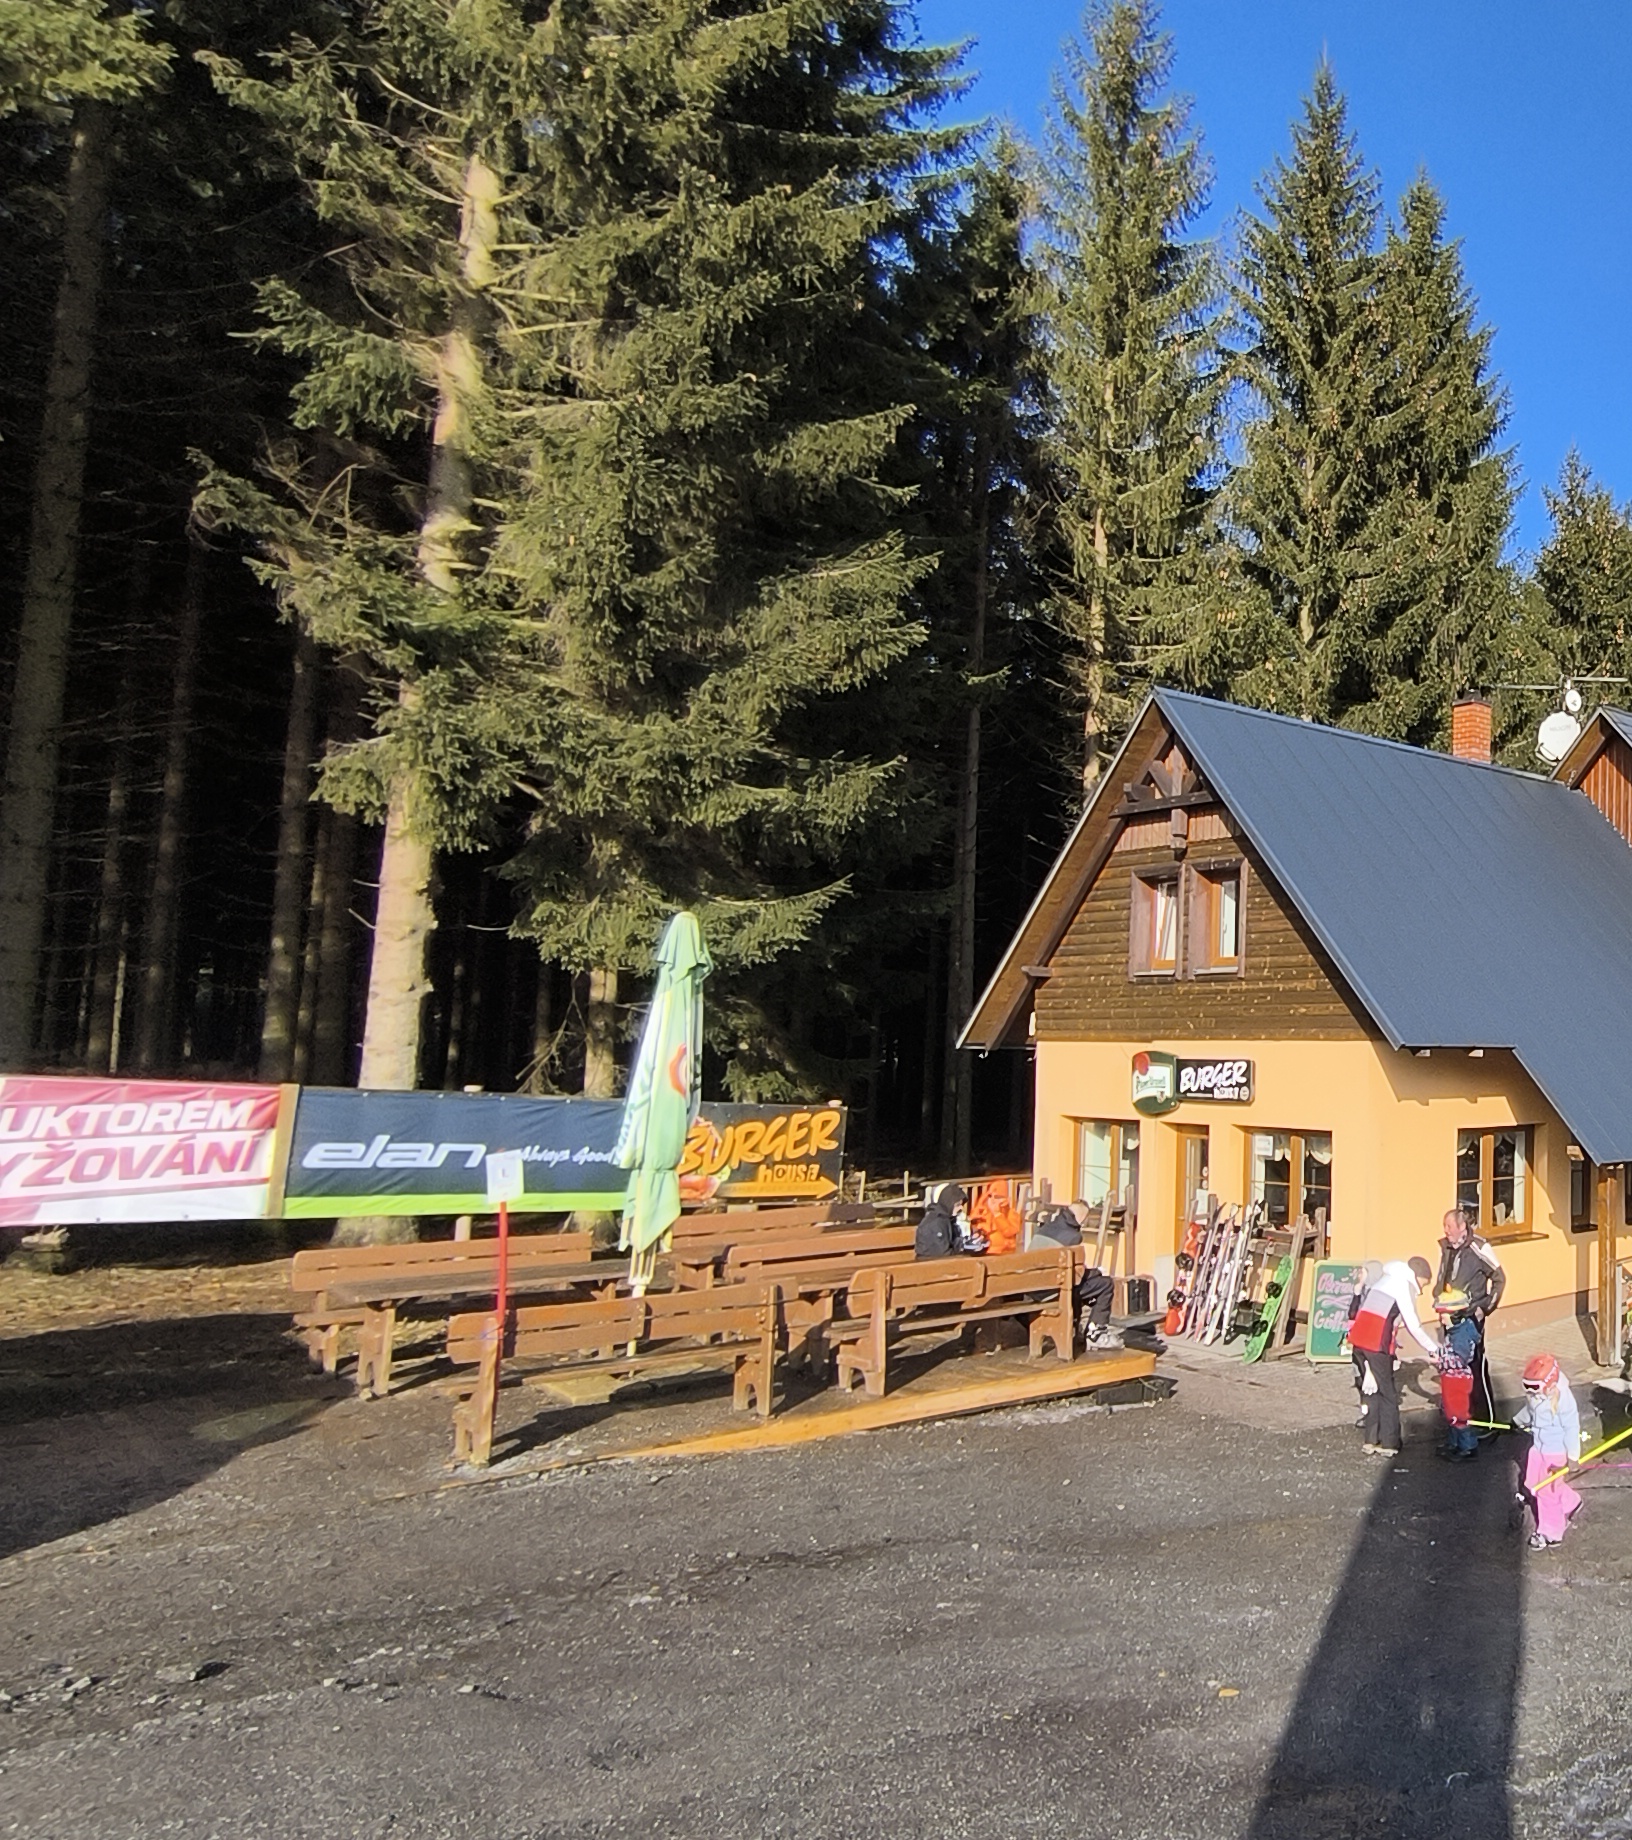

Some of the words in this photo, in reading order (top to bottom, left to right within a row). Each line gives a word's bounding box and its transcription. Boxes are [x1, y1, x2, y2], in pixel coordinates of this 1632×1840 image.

[1180, 1061, 1247, 1093] BURGER
[0, 1099, 255, 1140] UKTOREM
[302, 1134, 487, 1168] elan
[677, 1110, 841, 1176] BURGER
